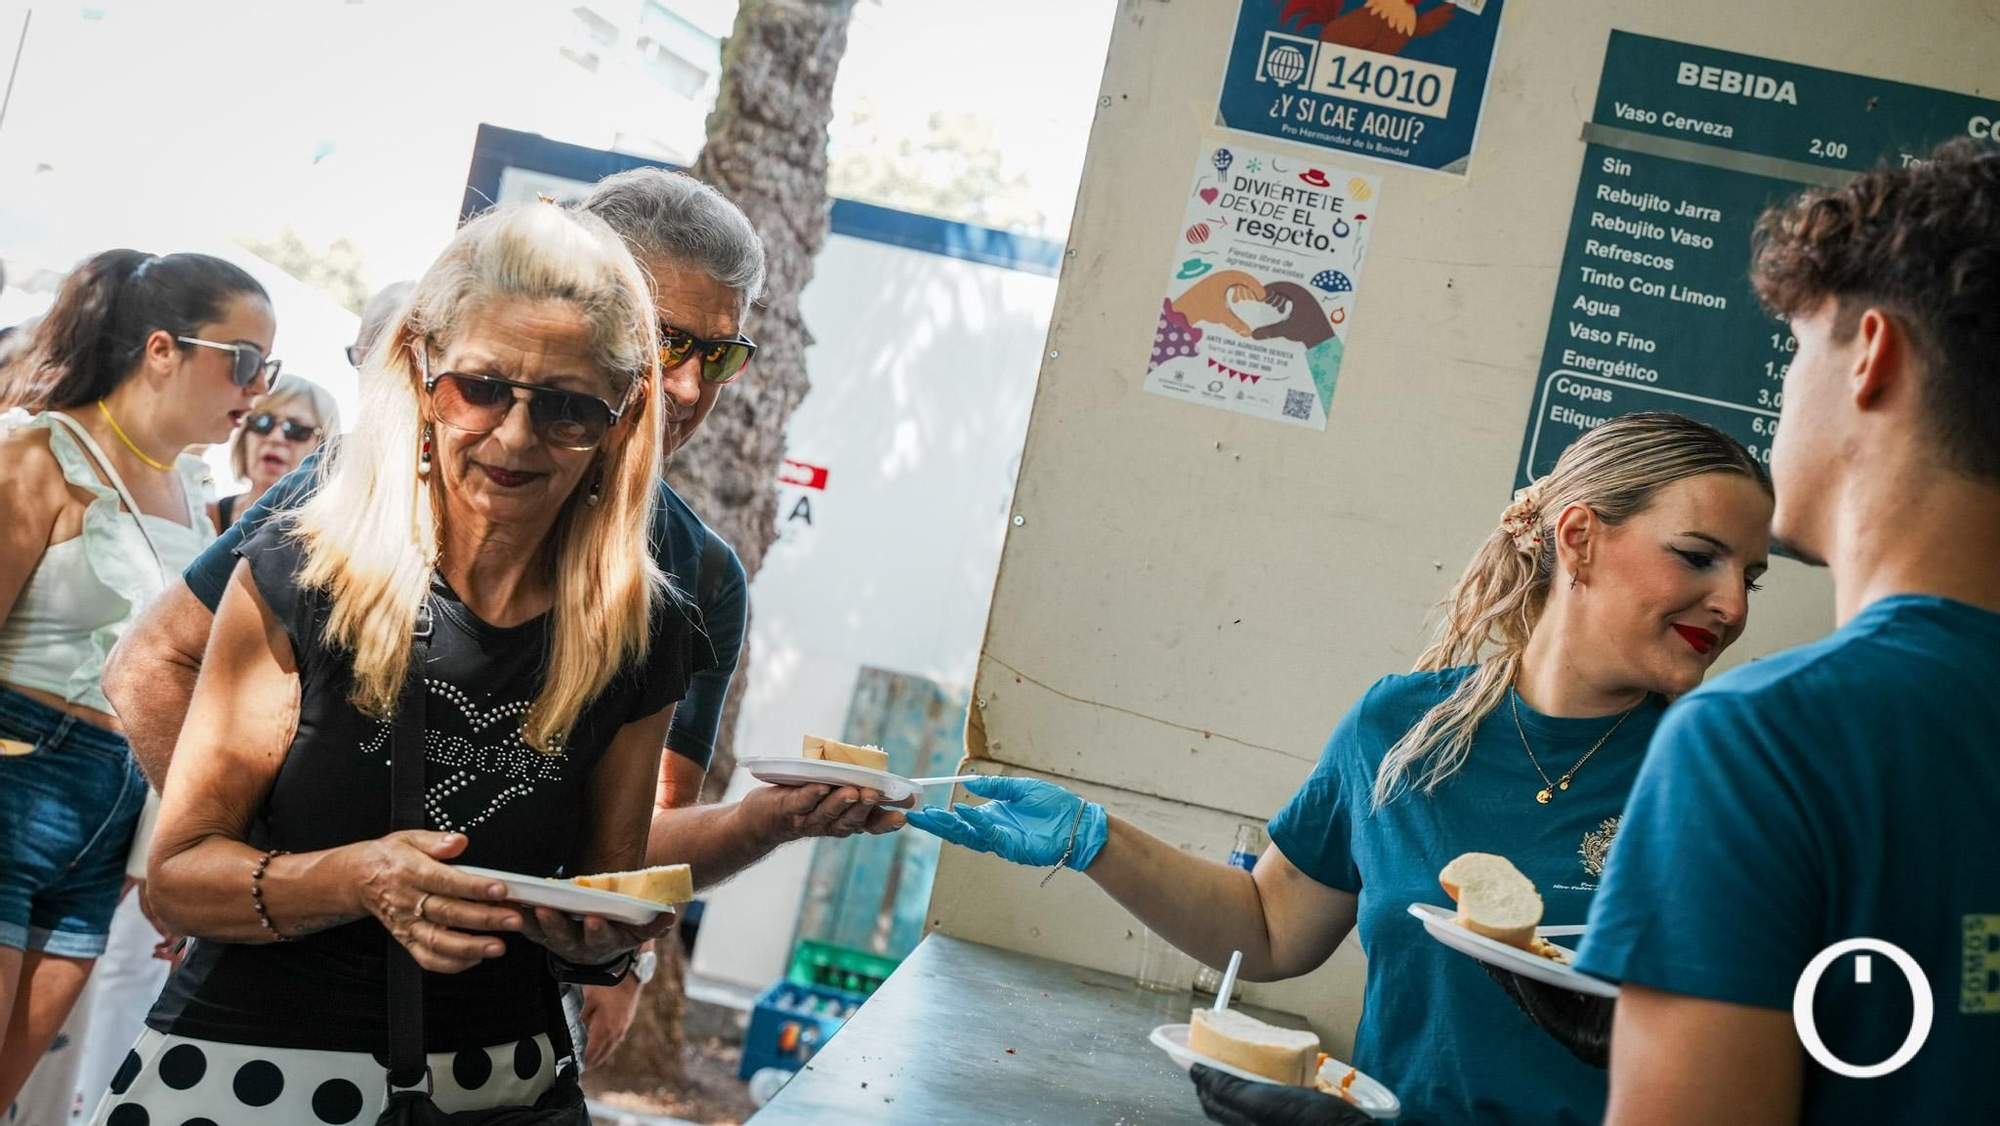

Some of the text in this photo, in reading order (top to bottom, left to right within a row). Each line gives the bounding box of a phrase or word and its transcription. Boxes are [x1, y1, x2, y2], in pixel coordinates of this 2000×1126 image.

[1327, 56, 1441, 107] 14010
[1677, 61, 1798, 105] BEBIDA
[1269, 94, 1425, 144] ¿Y SI CAE AQUÍ?
[1281, 123, 1409, 157] Pro Hermandad de la Bondad
[1614, 101, 1848, 160] Vaso Cerveza 2,00
[1602, 156, 1632, 177] Sin
[1219, 193, 1316, 227] DESDE EL
[1233, 176, 1345, 213] DIVIÉRTETE
[1596, 184, 1722, 223] Rebujito Jarra
[1590, 212, 1714, 250] Rebujito Vaso
[1585, 239, 1675, 271] Refrescos
[1580, 266, 1727, 310] Tinto Con Limon
[1572, 295, 1797, 352] Agua 1,0
[1568, 321, 1790, 381] Vaso Fino 1,5
[1562, 349, 1783, 408] Energético 3,0
[1550, 405, 1613, 430] Etique
[1556, 377, 1778, 437] Copas 6,0
